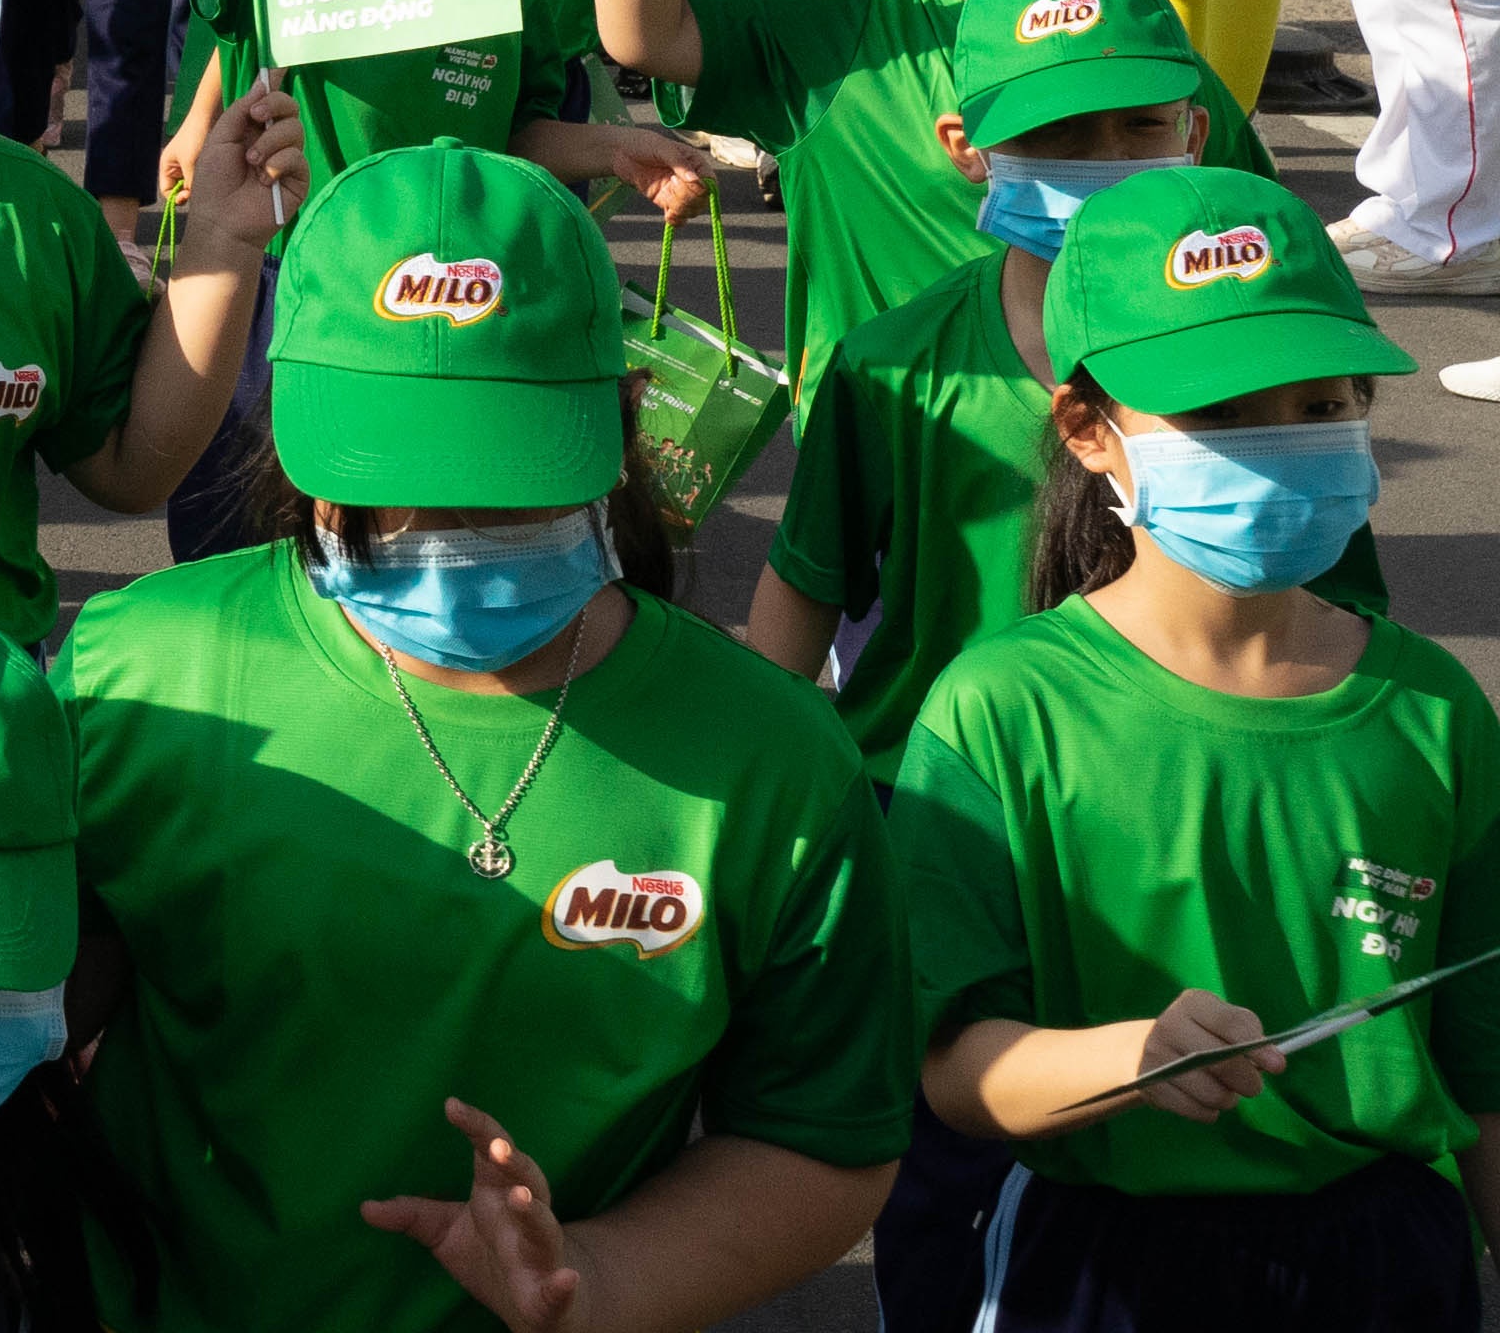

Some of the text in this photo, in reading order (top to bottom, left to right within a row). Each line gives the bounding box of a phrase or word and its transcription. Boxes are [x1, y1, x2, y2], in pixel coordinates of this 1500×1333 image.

[281, 3, 355, 39] NĂNG
[1029, 4, 1095, 32] MILO
[432, 67, 470, 87] NGÀY
[1182, 241, 1265, 279] MILO
[394, 275, 493, 307] MILO
[562, 886, 688, 934] MILO
